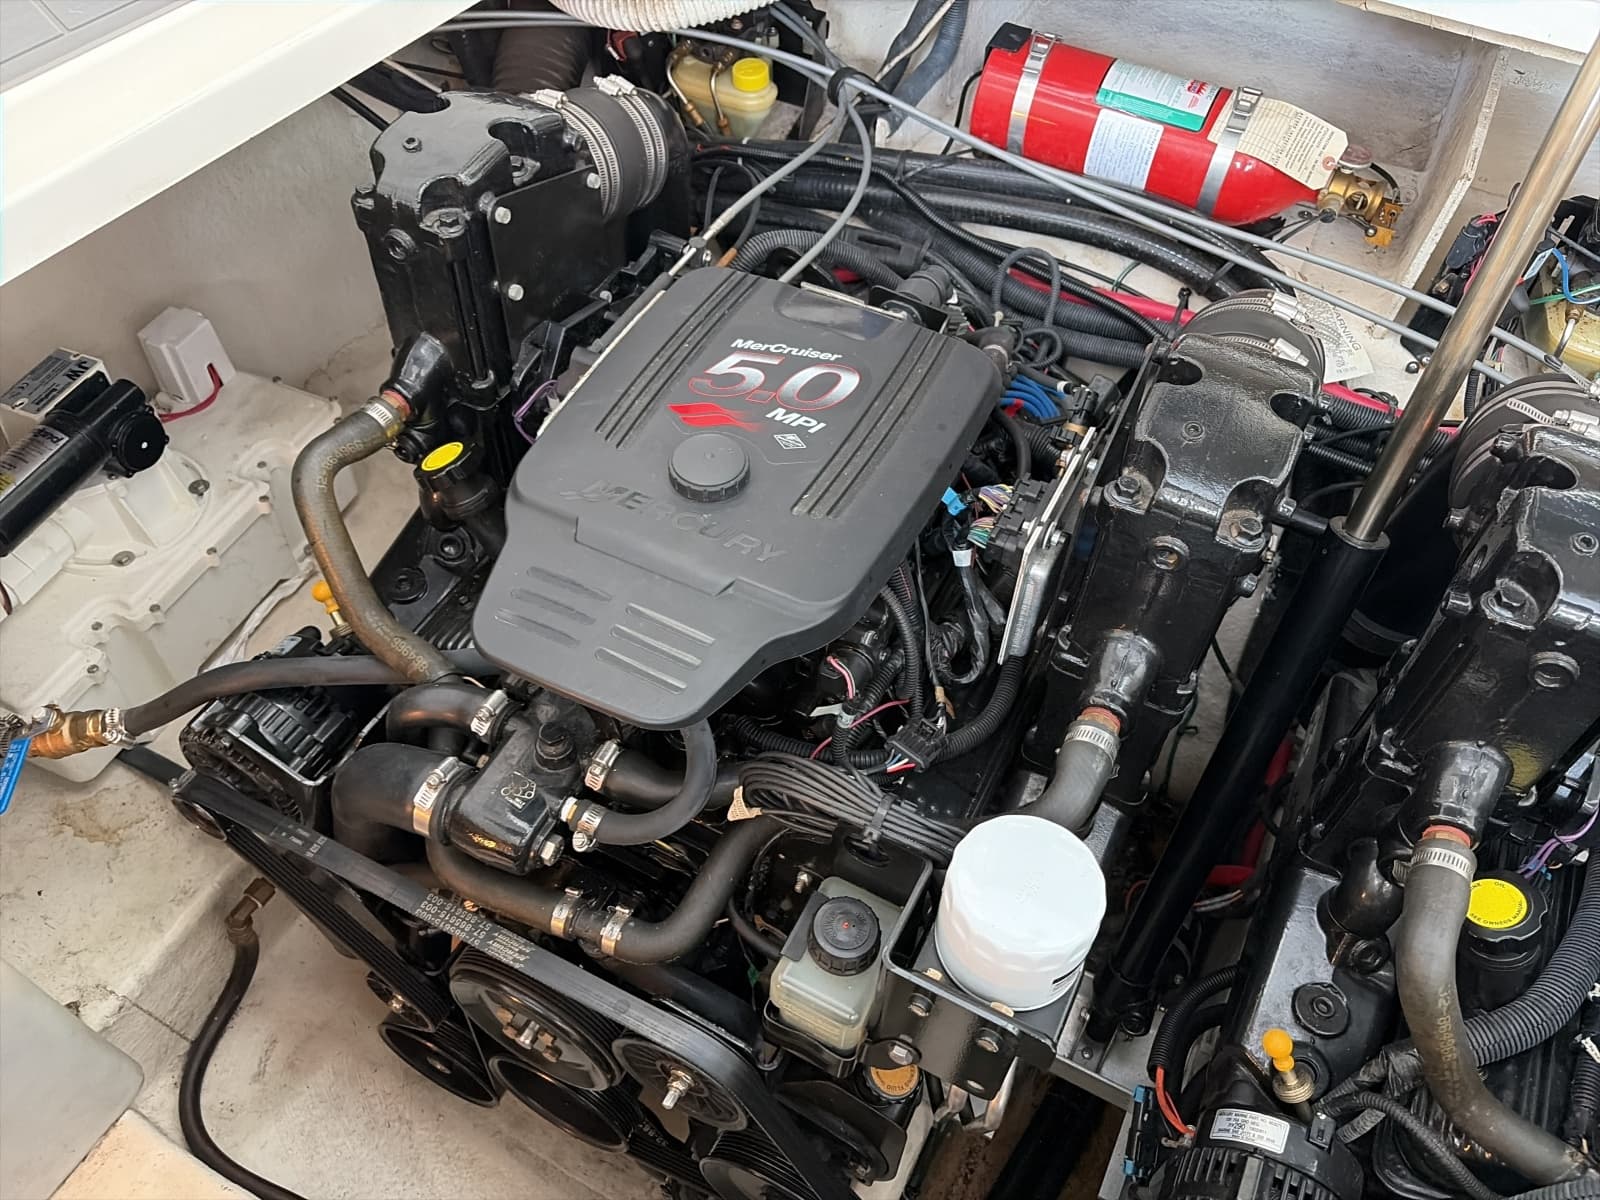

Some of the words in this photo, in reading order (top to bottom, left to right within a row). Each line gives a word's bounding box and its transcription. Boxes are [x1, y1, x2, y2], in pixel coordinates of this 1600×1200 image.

[730, 338, 843, 361] MerCruiser
[690, 350, 861, 411] 5.0
[765, 407, 828, 434] MPI
[562, 479, 788, 563] MERCURY
